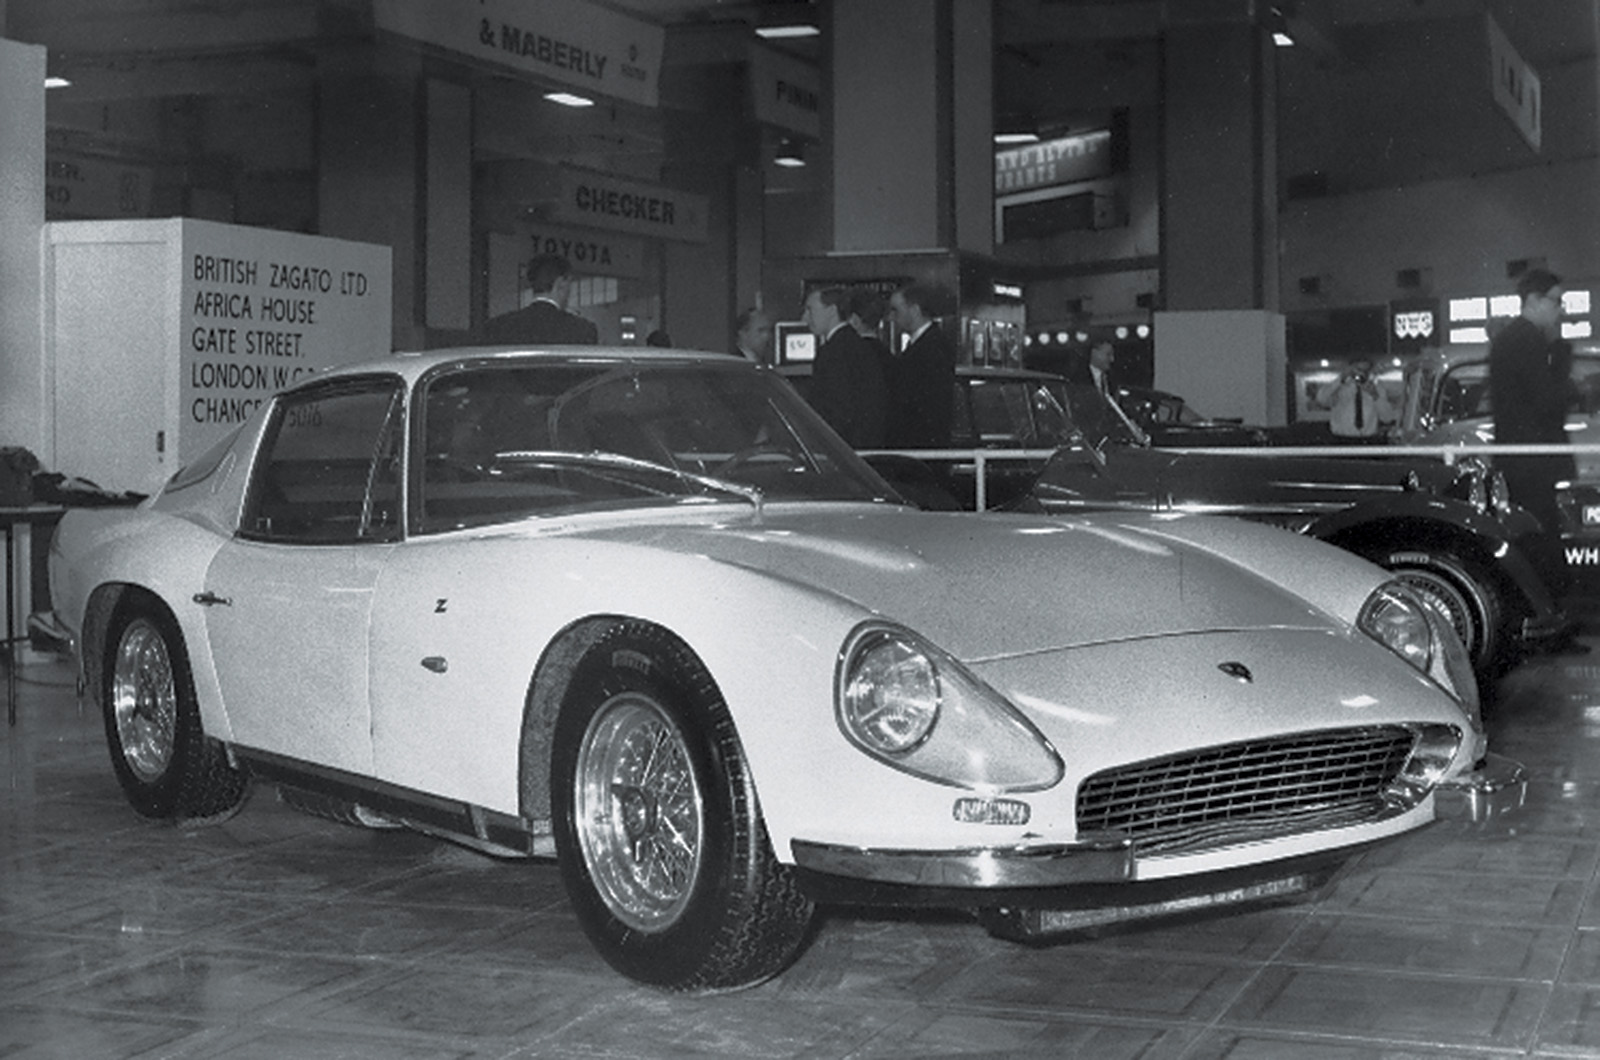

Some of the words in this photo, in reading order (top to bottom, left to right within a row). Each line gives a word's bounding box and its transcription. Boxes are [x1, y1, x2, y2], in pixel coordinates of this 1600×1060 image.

[479, 17, 496, 48] &
[501, 24, 607, 79] MABERLY
[576, 185, 675, 225] CHECKER
[531, 235, 612, 265] TOYOTA
[193, 254, 258, 286] BRITISH
[270, 263, 333, 294] ZAGATO
[193, 291, 254, 320] AFRICA
[192, 327, 237, 355] GATE
